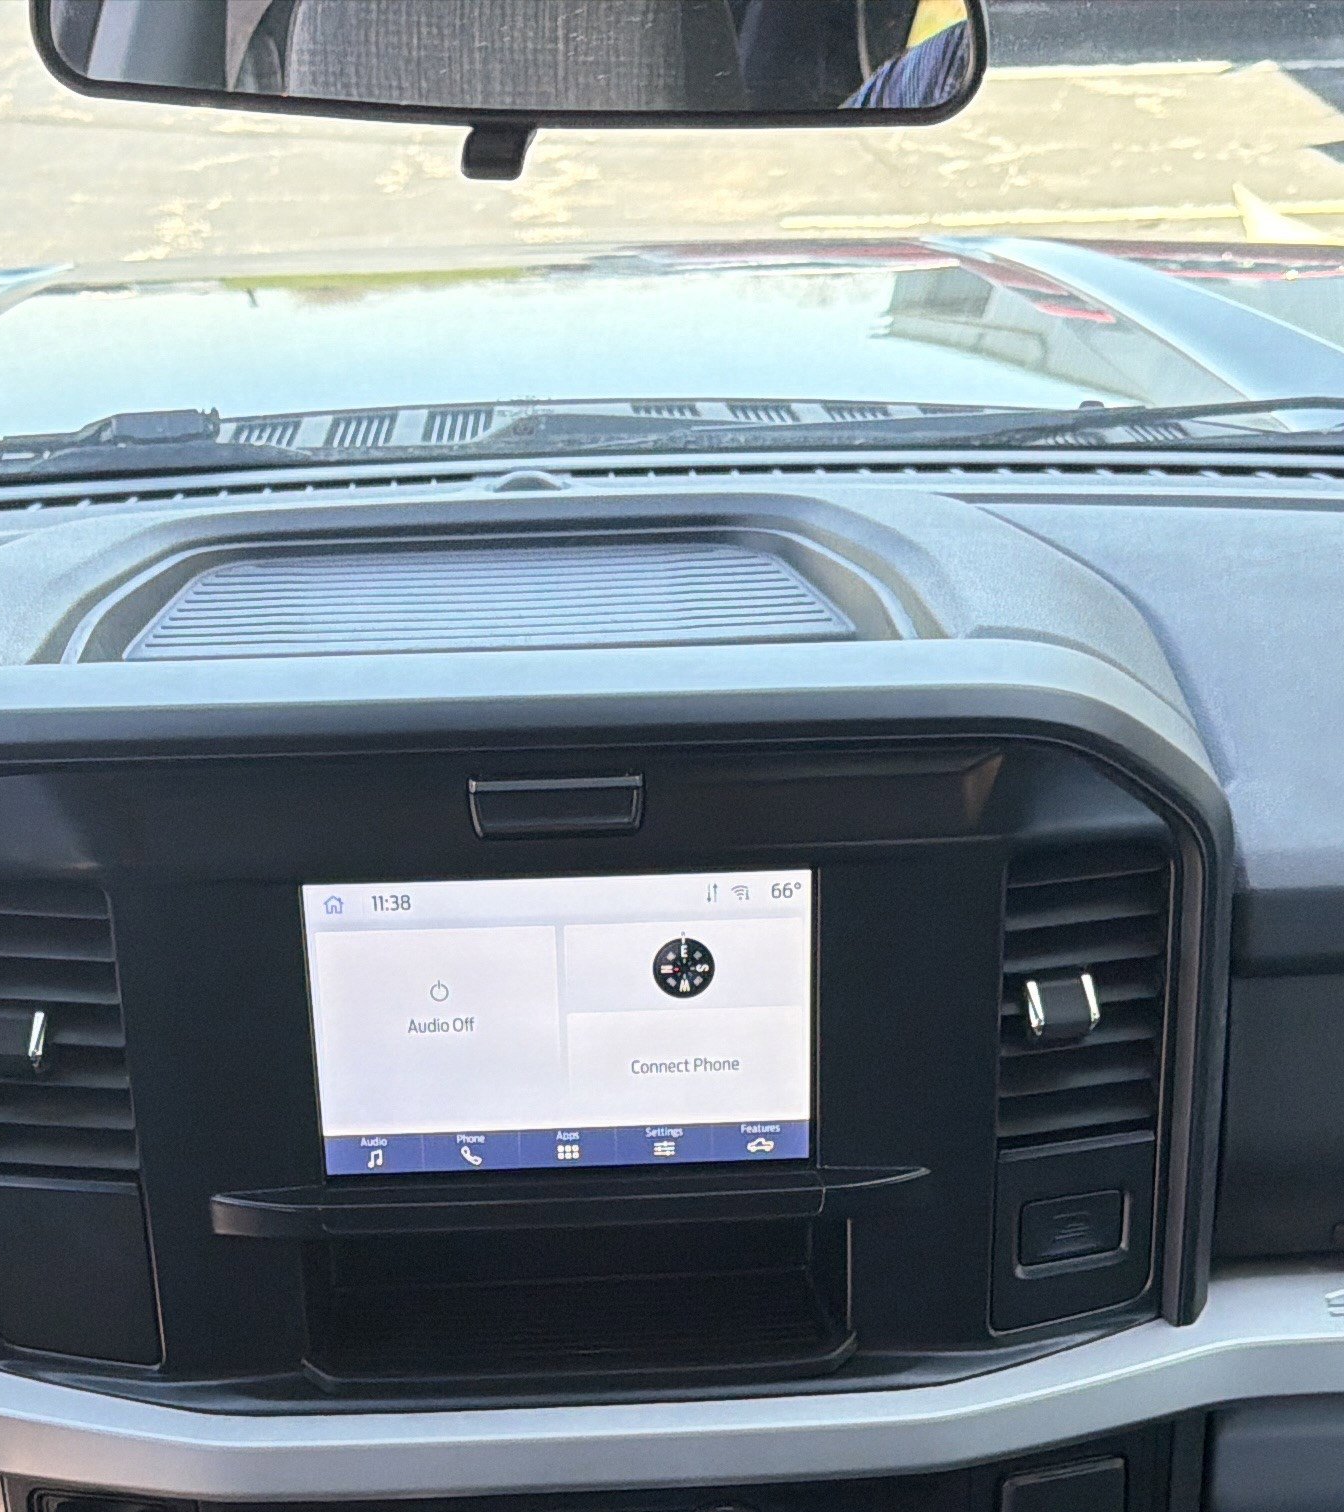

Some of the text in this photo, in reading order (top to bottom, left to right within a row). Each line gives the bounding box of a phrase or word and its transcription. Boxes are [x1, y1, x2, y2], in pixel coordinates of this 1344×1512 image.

[770, 882, 803, 900] 66°
[371, 894, 412, 913] 11:38
[407, 1017, 475, 1034] Audio Off
[631, 1056, 740, 1075] Connect Phone
[645, 1126, 684, 1139] Settings
[740, 1123, 781, 1135] Features
[360, 1136, 388, 1148] Audio
[456, 1133, 486, 1145] Phone
[556, 1131, 580, 1143] Apps
